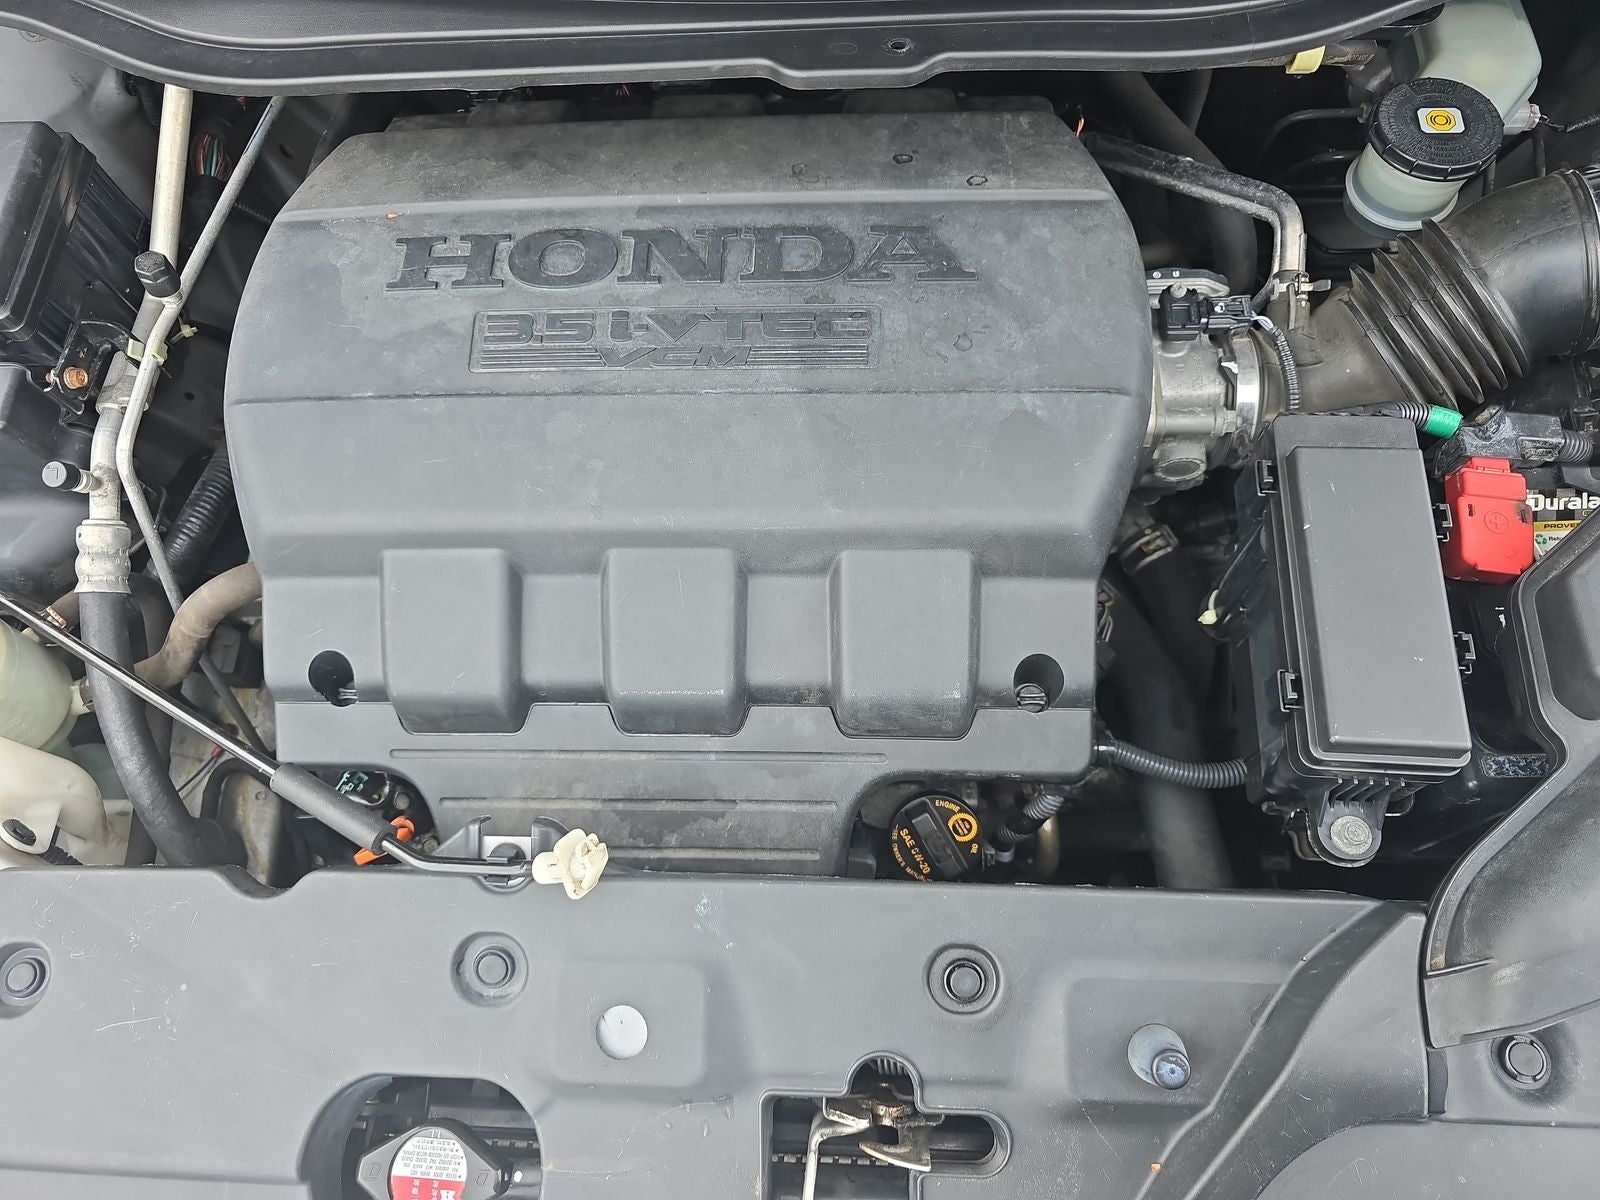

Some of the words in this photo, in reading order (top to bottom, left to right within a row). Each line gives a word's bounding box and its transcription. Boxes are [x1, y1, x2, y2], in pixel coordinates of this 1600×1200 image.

[385, 225, 979, 291] HONDA
[609, 308, 872, 344] i-VTEC
[597, 345, 752, 368] VCM
[1525, 492, 1600, 511] Durala
[900, 828, 916, 848] SAE
[935, 799, 961, 813] ENGINE
[970, 843, 979, 854] OIL
